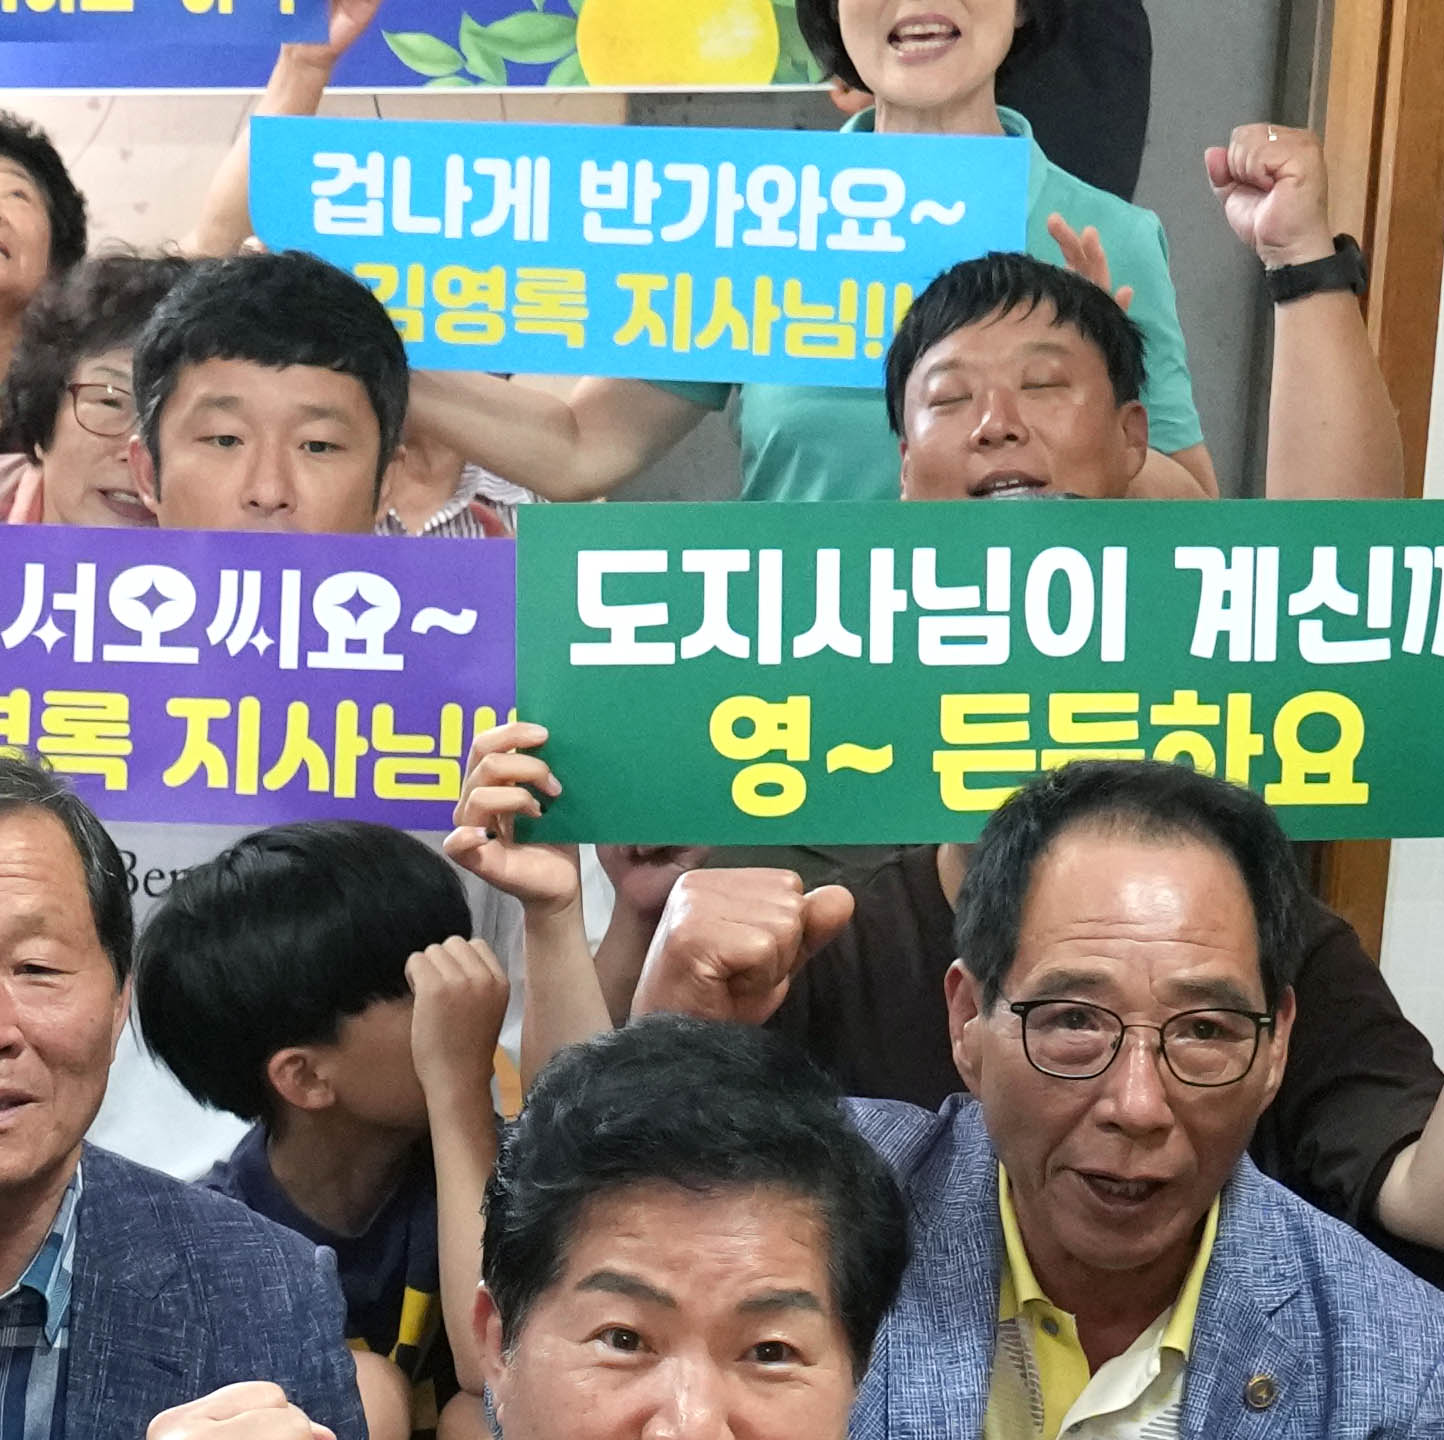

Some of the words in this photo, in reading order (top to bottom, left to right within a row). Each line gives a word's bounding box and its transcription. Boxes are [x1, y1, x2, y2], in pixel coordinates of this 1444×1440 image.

[311, 152, 550, 241] 겁나게
[580, 160, 965, 252] 반가와요~
[356, 265, 587, 346] 김영록
[570, 546, 1127, 666] 도지사님이
[709, 695, 893, 817] 영~
[932, 690, 1369, 812] 든든하요
